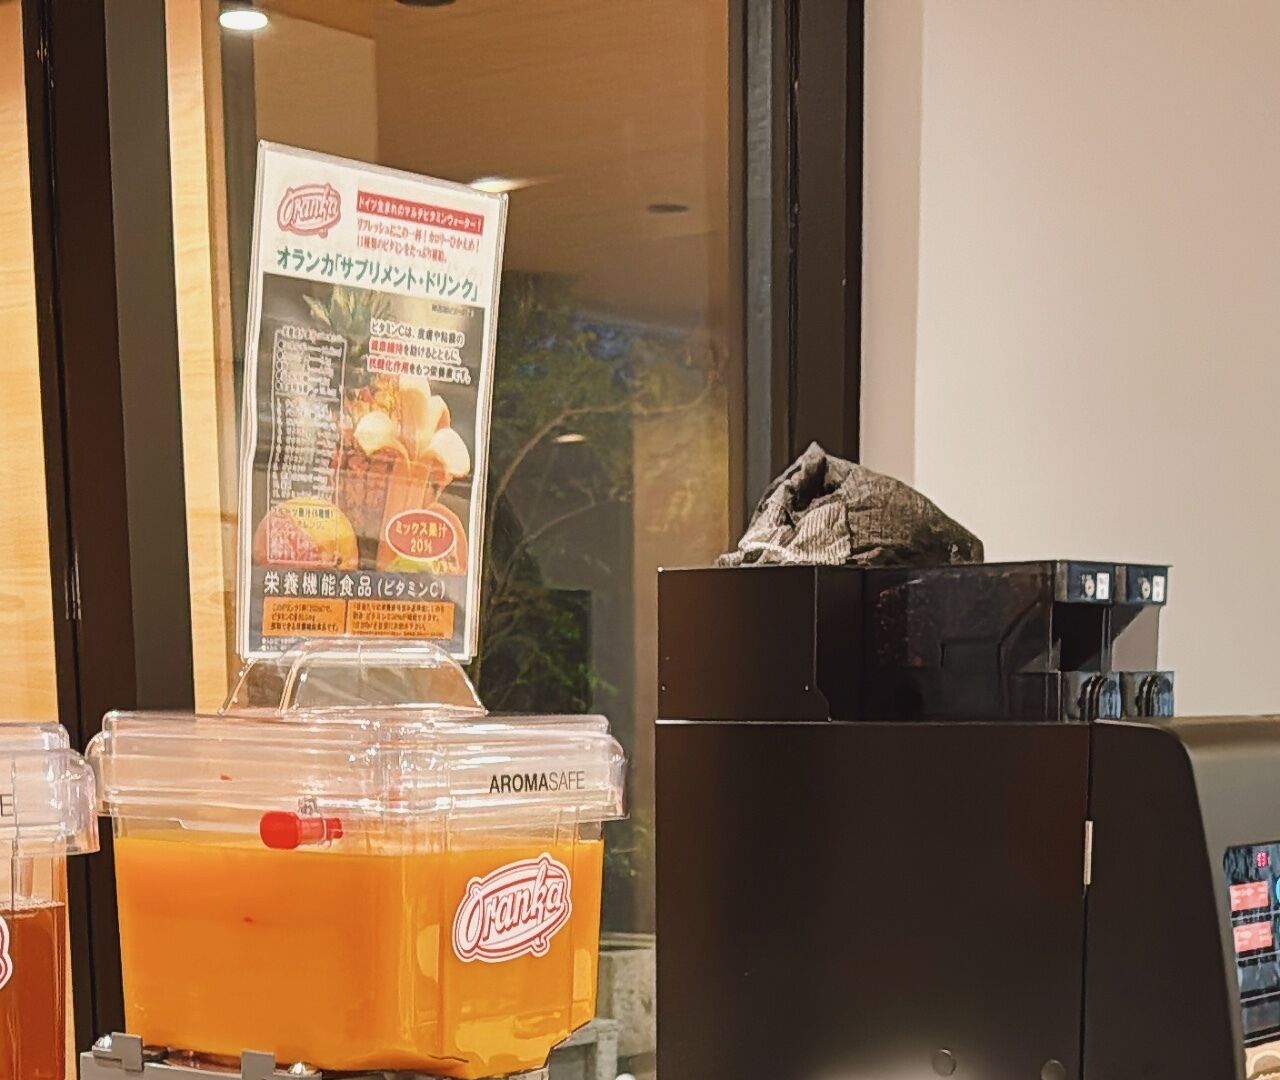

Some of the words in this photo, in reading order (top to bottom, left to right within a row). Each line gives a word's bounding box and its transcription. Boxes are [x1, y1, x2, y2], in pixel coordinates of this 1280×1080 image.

[276, 245, 478, 302] オランカ「サプリメント・ドリンク」
[395, 520, 448, 539] ミックス果汁
[410, 538, 433, 554] 20%
[483, 771, 585, 793] AROMASAFE
[458, 863, 565, 952] Oranka
